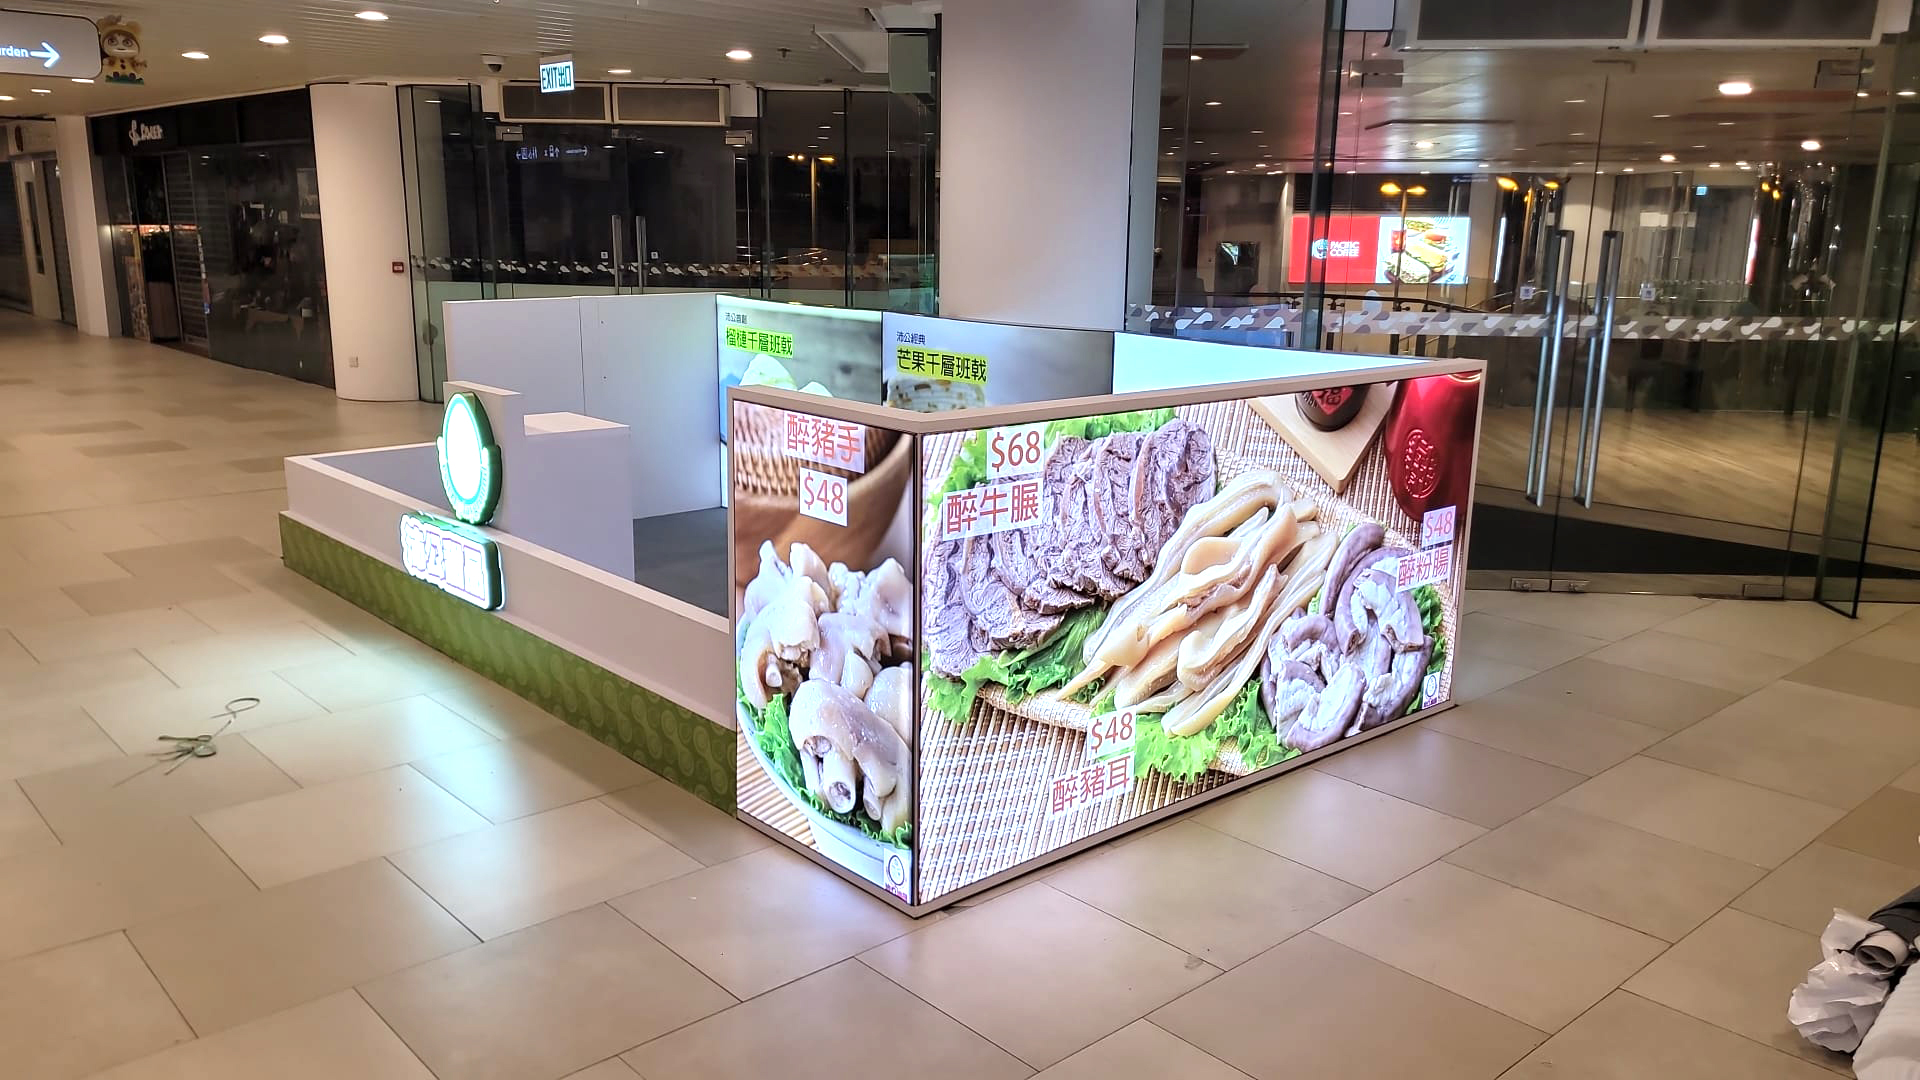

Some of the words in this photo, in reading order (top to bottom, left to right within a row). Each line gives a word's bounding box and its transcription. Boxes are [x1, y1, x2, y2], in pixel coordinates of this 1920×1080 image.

[0, 46, 29, 57] rden
[541, 67, 557, 90] EXIT
[558, 65, 572, 88] 出口
[1330, 241, 1360, 249] PACIFIC
[1330, 249, 1359, 257] COFFEE
[897, 348, 987, 382] 芒果千層班戟
[787, 413, 861, 464] 醉豬手
[991, 431, 1041, 472] $68
[803, 471, 844, 515] $48
[1425, 511, 1453, 541] $48
[1399, 548, 1448, 587] 醉粉腸
[1091, 712, 1133, 753] $48
[1053, 756, 1131, 814] 醉豬耳
